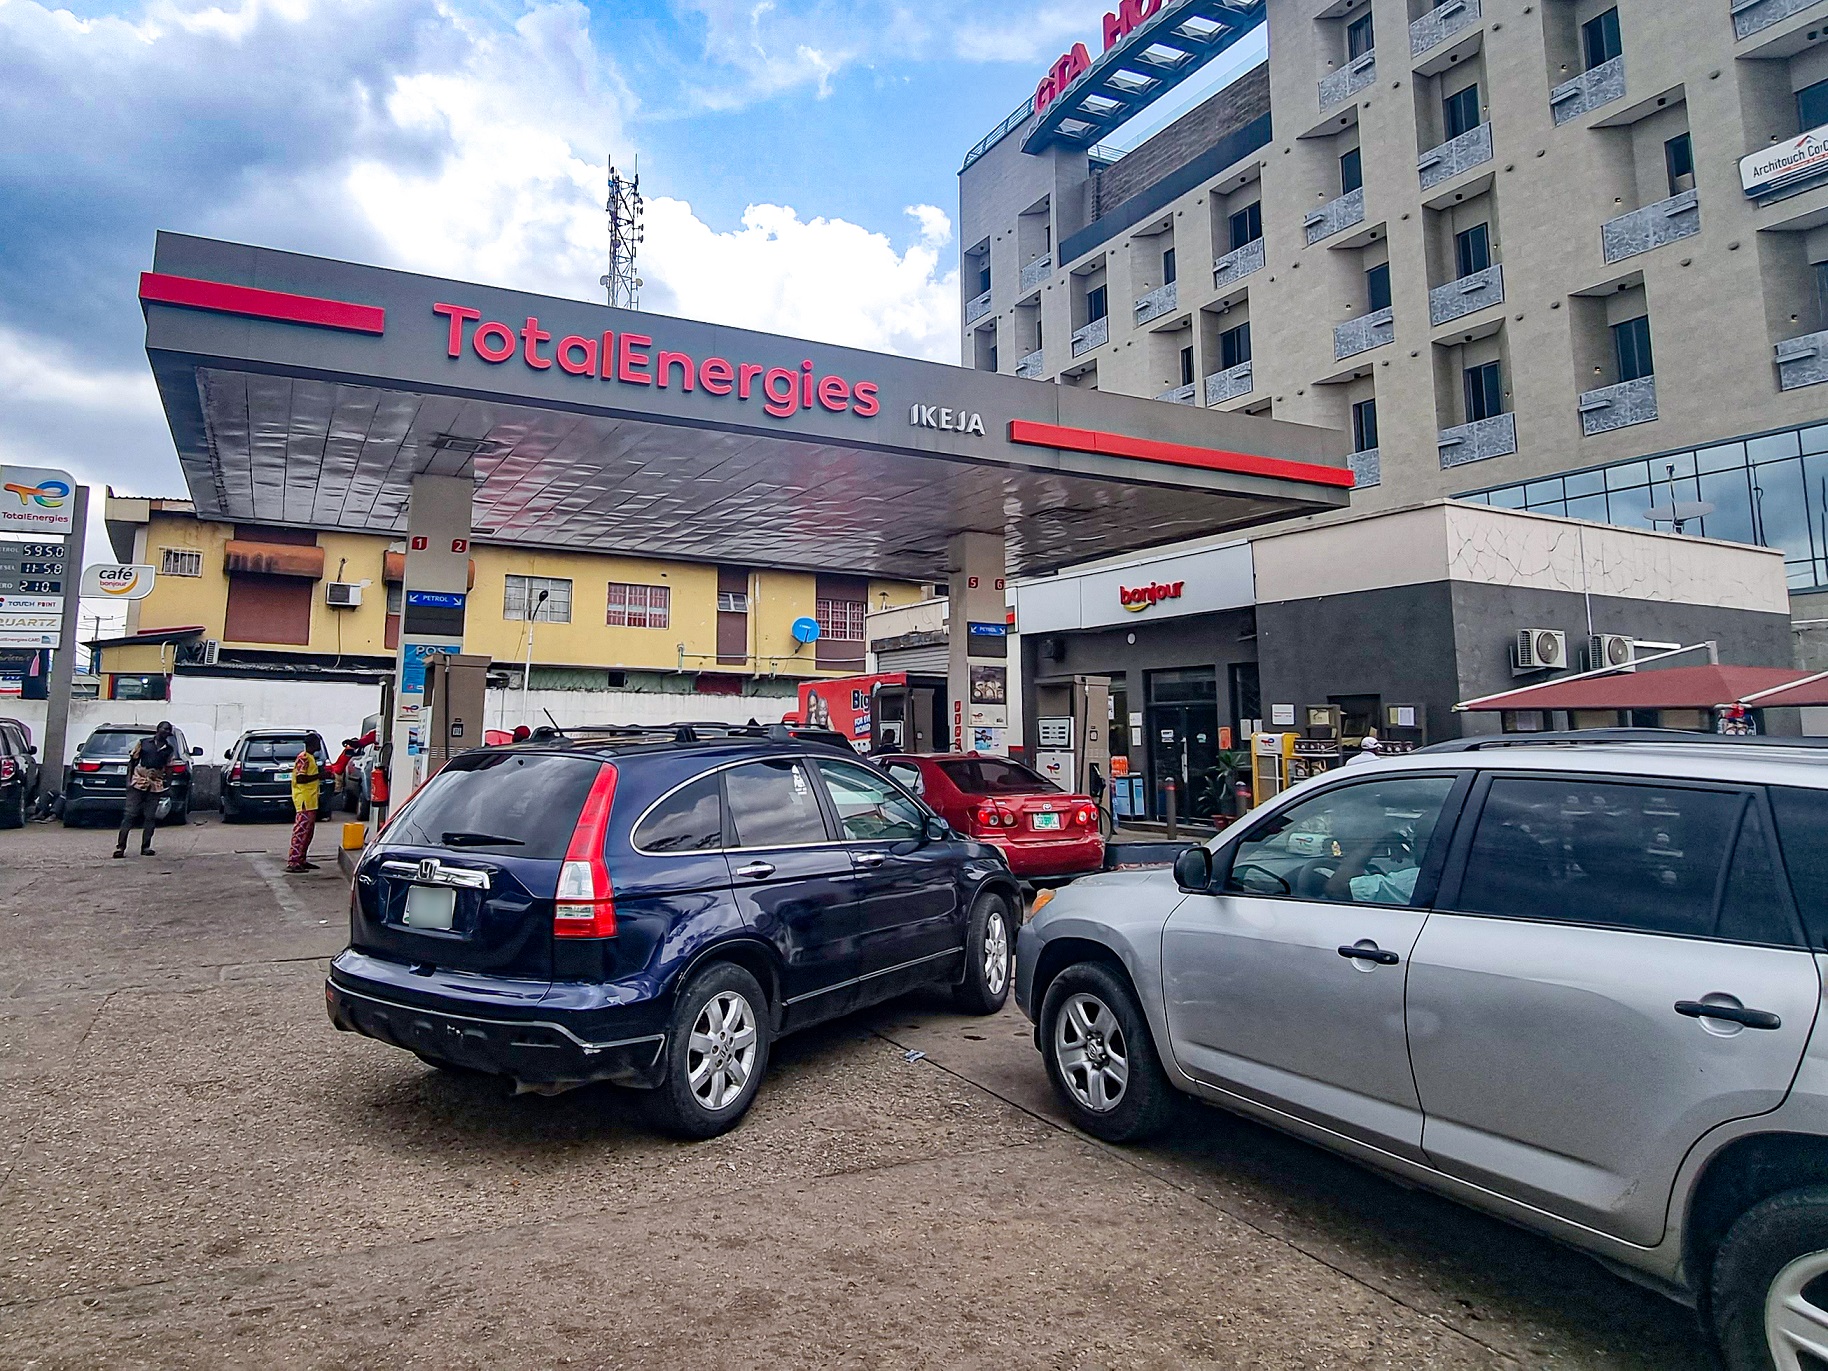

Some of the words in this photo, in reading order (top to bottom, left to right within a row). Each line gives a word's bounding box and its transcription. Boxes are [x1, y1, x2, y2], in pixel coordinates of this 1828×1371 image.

[1102, 0, 1172, 50] HO
[1753, 150, 1806, 178] Architouch
[433, 302, 880, 418] TotalEnergies
[910, 403, 986, 437] IKEJA
[2, 511, 69, 523] TotalEnergies
[24, 545, 65, 557] 595.0
[416, 538, 423, 549] 1
[455, 540, 463, 552] 2
[98, 567, 134, 580] café
[970, 578, 977, 588] 5
[996, 580, 1003, 589] 6
[422, 594, 448, 603] PETROL
[1119, 581, 1185, 606] bonjour
[415, 645, 447, 656] POS
[851, 689, 871, 714] Big
